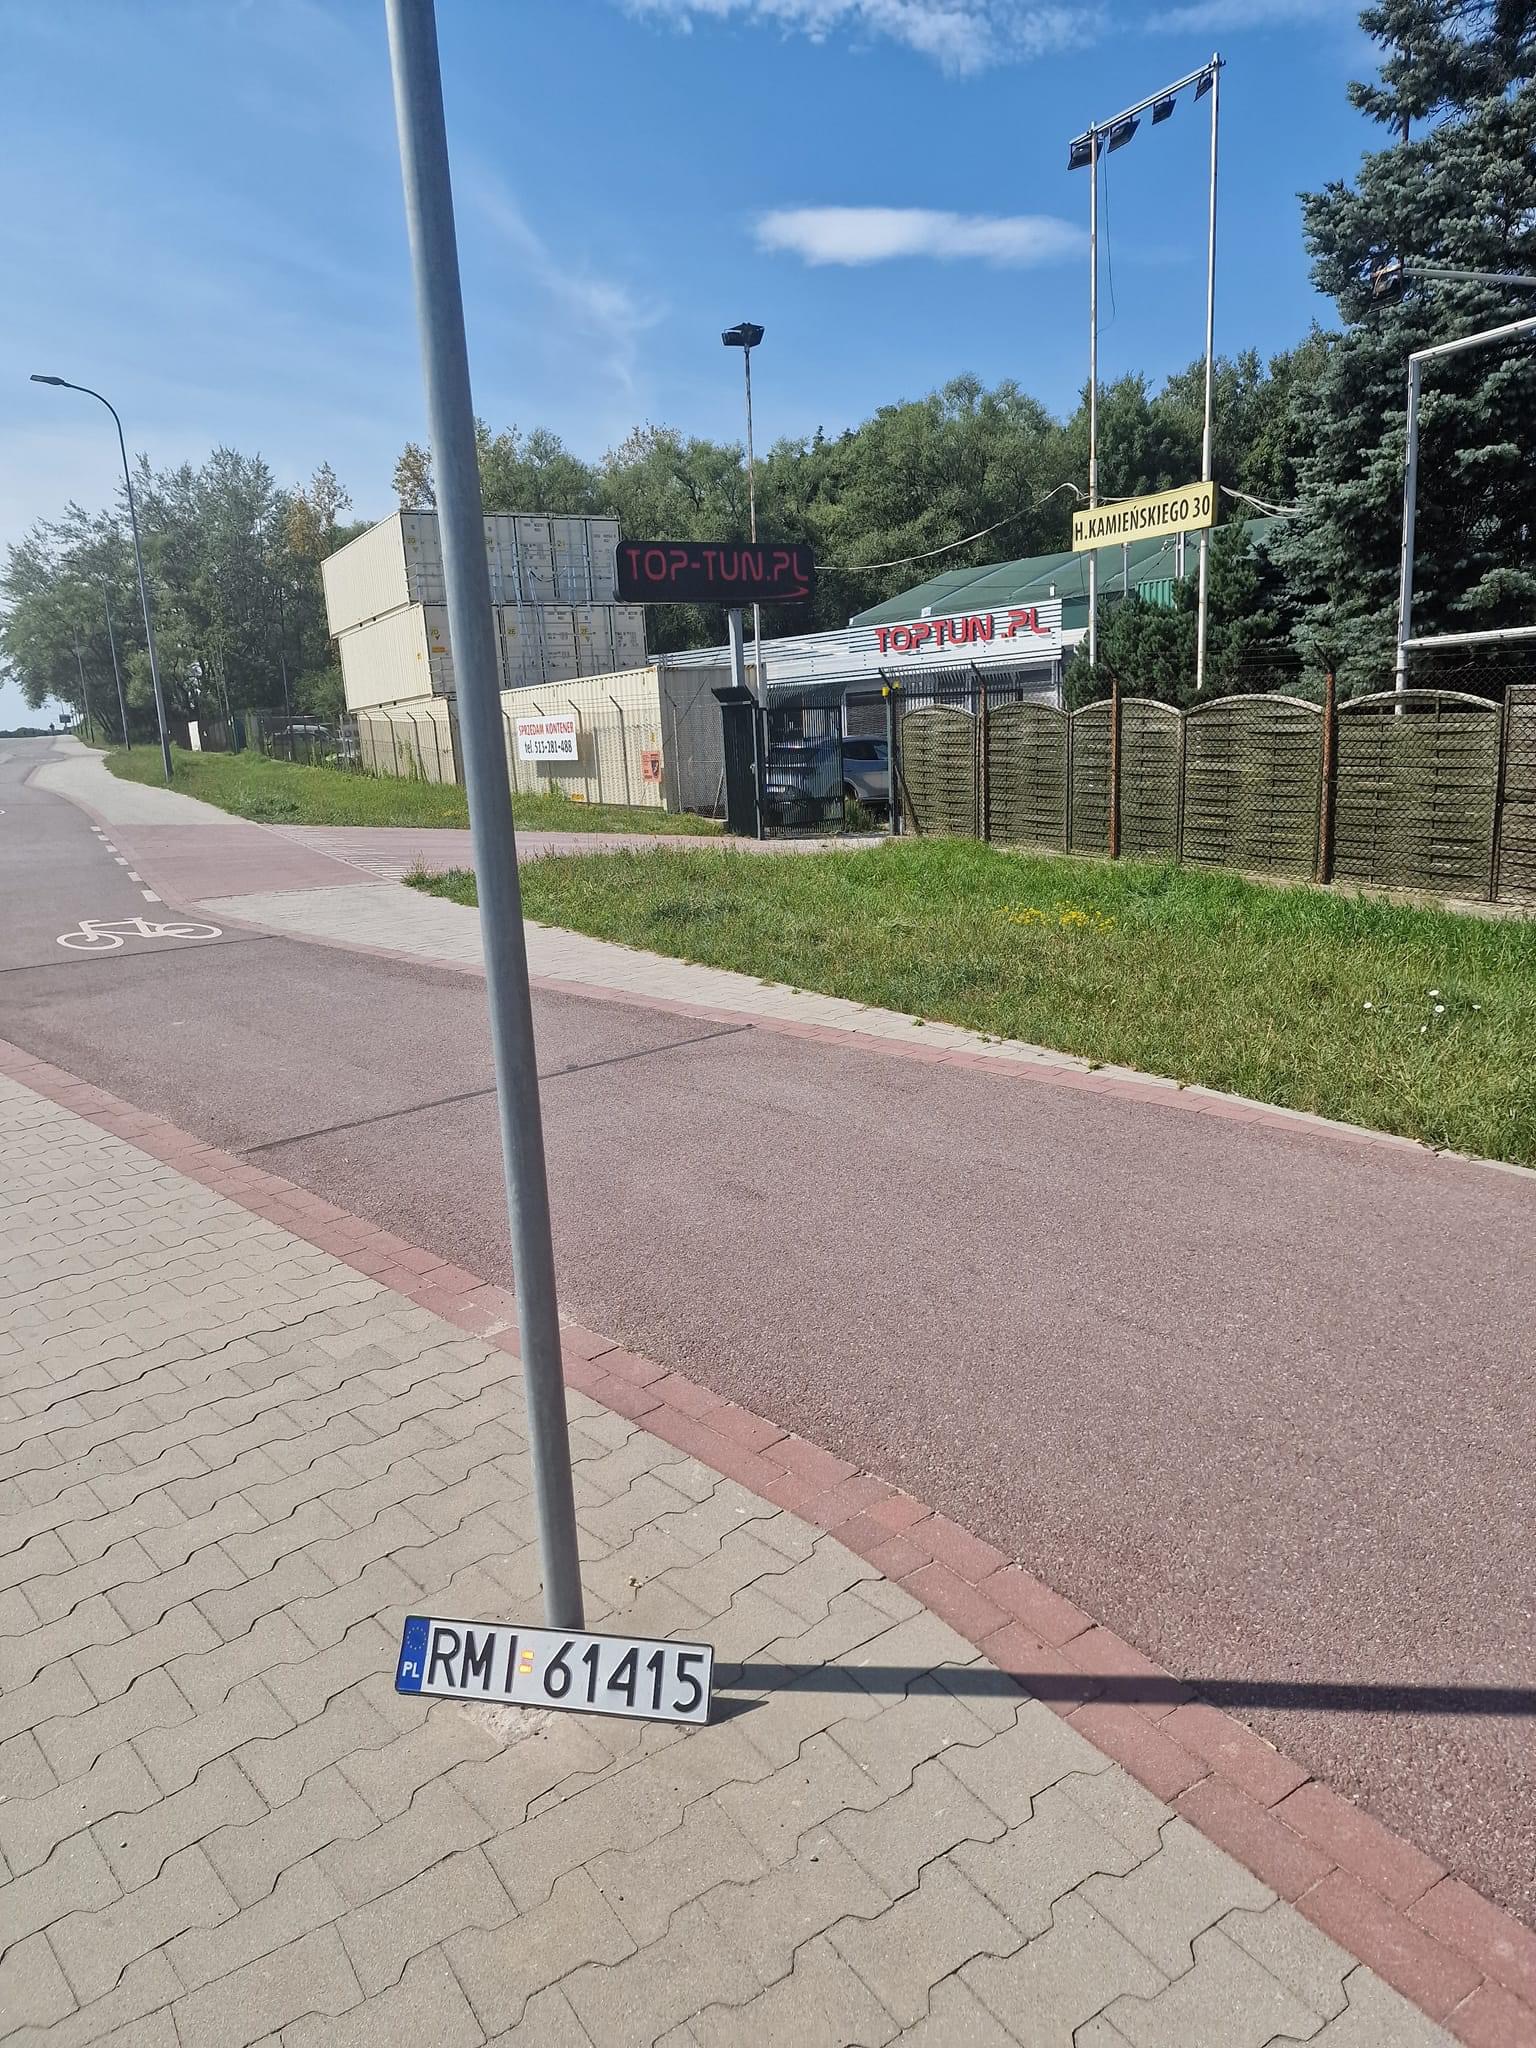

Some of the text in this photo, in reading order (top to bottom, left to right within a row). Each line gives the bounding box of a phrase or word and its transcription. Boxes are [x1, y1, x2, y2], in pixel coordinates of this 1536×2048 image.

[1074, 495, 1210, 541] H.KAMIEŃSKIEGO 30
[627, 549, 809, 581] TOP-TUN.PL
[518, 721, 574, 736] SPRZEDAM KONTENER
[401, 1661, 420, 1679] PL
[427, 1627, 704, 1714] RMI 61415
